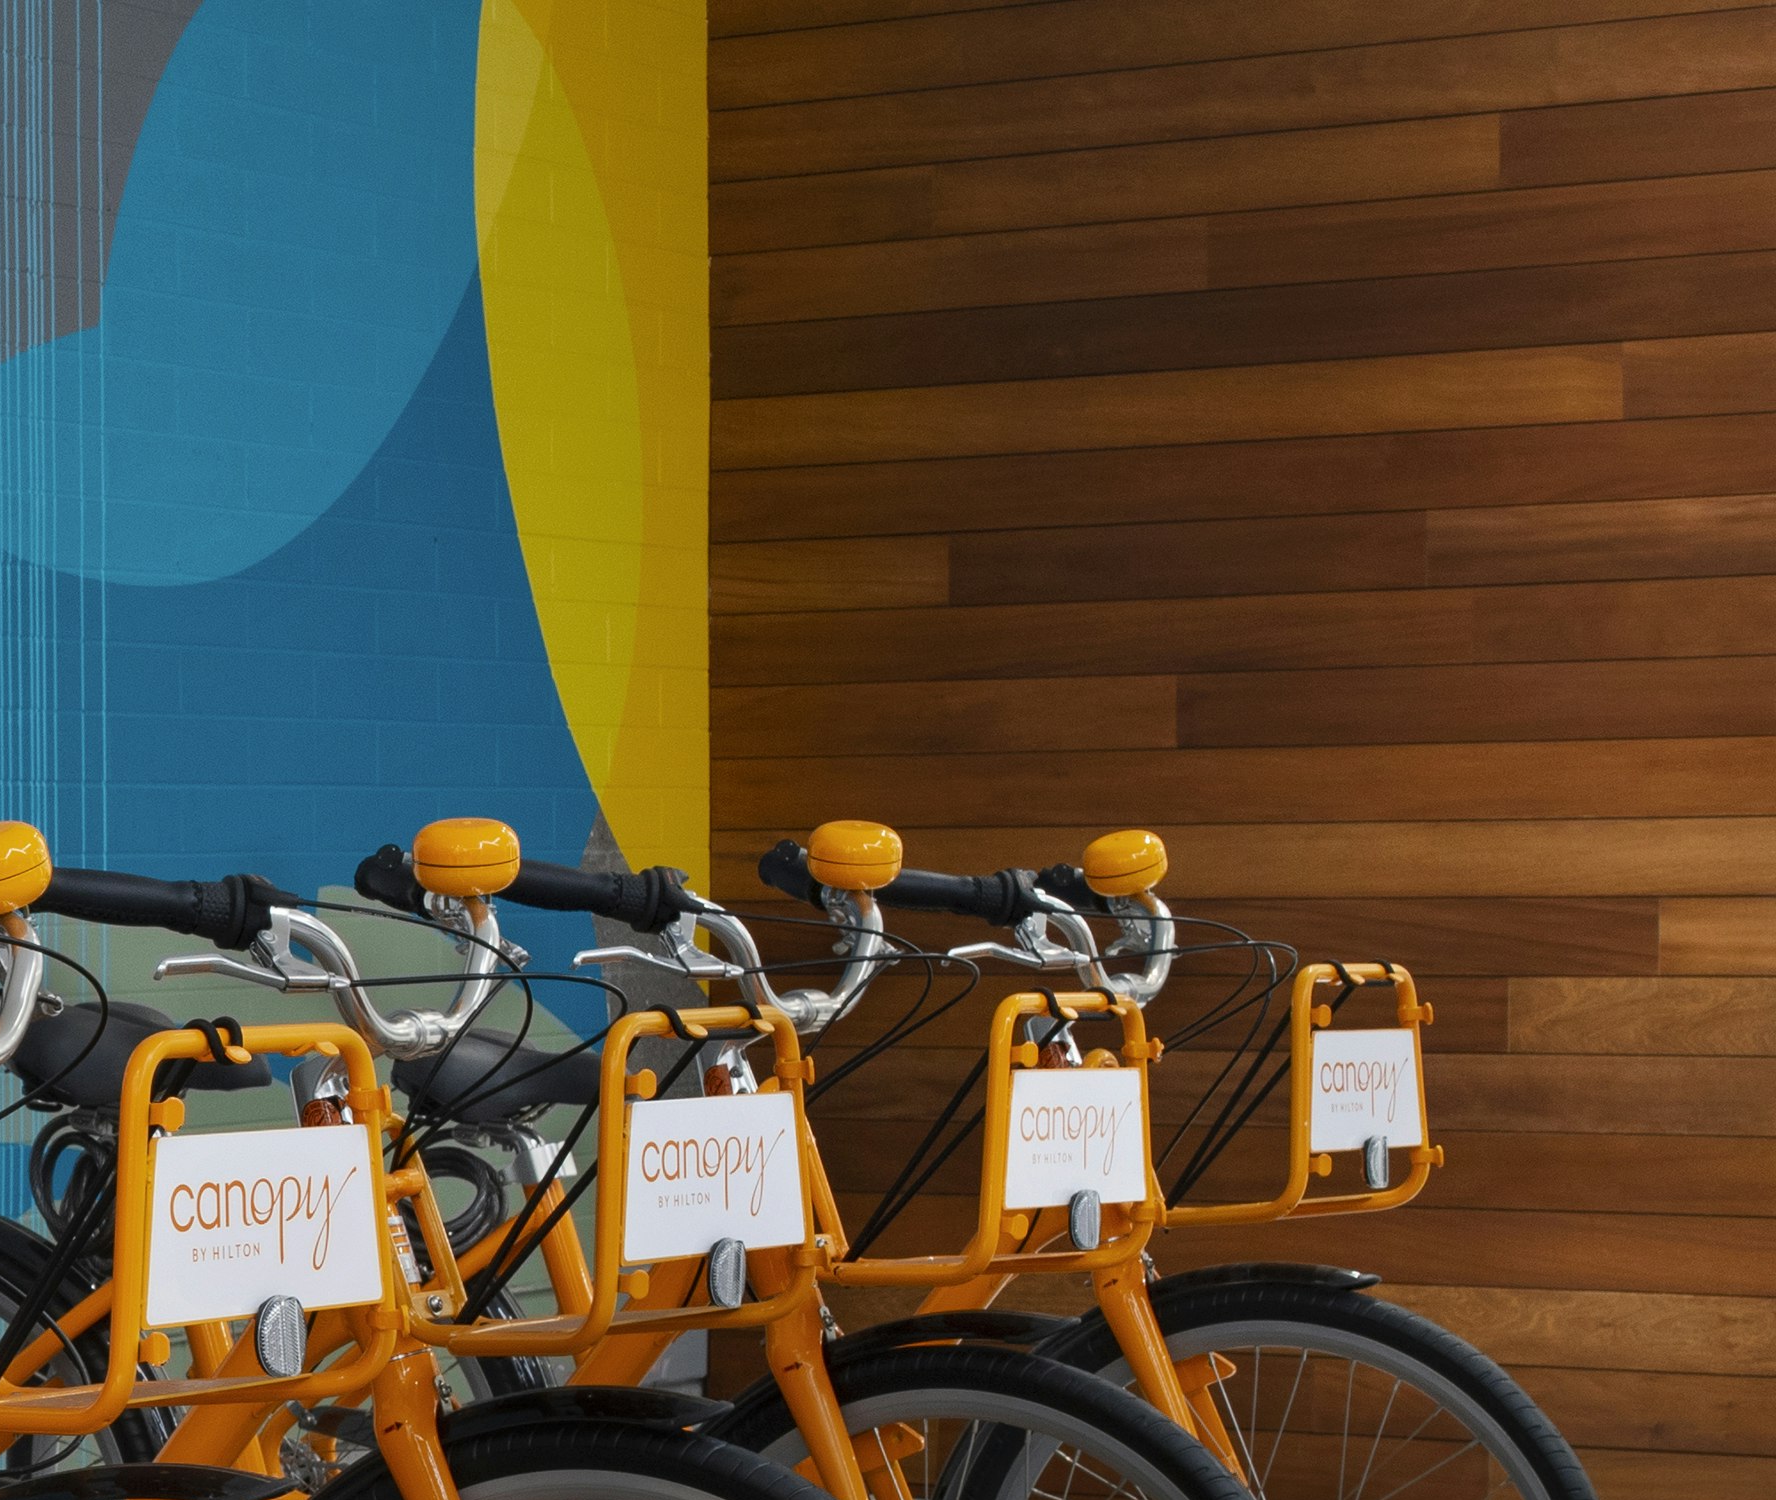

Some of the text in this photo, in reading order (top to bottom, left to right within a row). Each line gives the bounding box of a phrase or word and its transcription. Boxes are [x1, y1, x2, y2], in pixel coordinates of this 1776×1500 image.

[1321, 1058, 1408, 1123] canopy
[642, 1129, 784, 1216] canopy
[1020, 1102, 1131, 1176] canopy
[170, 1167, 357, 1270] canopy
[658, 1192, 710, 1208] BY HILTON
[193, 1243, 260, 1262] BY HILTON
